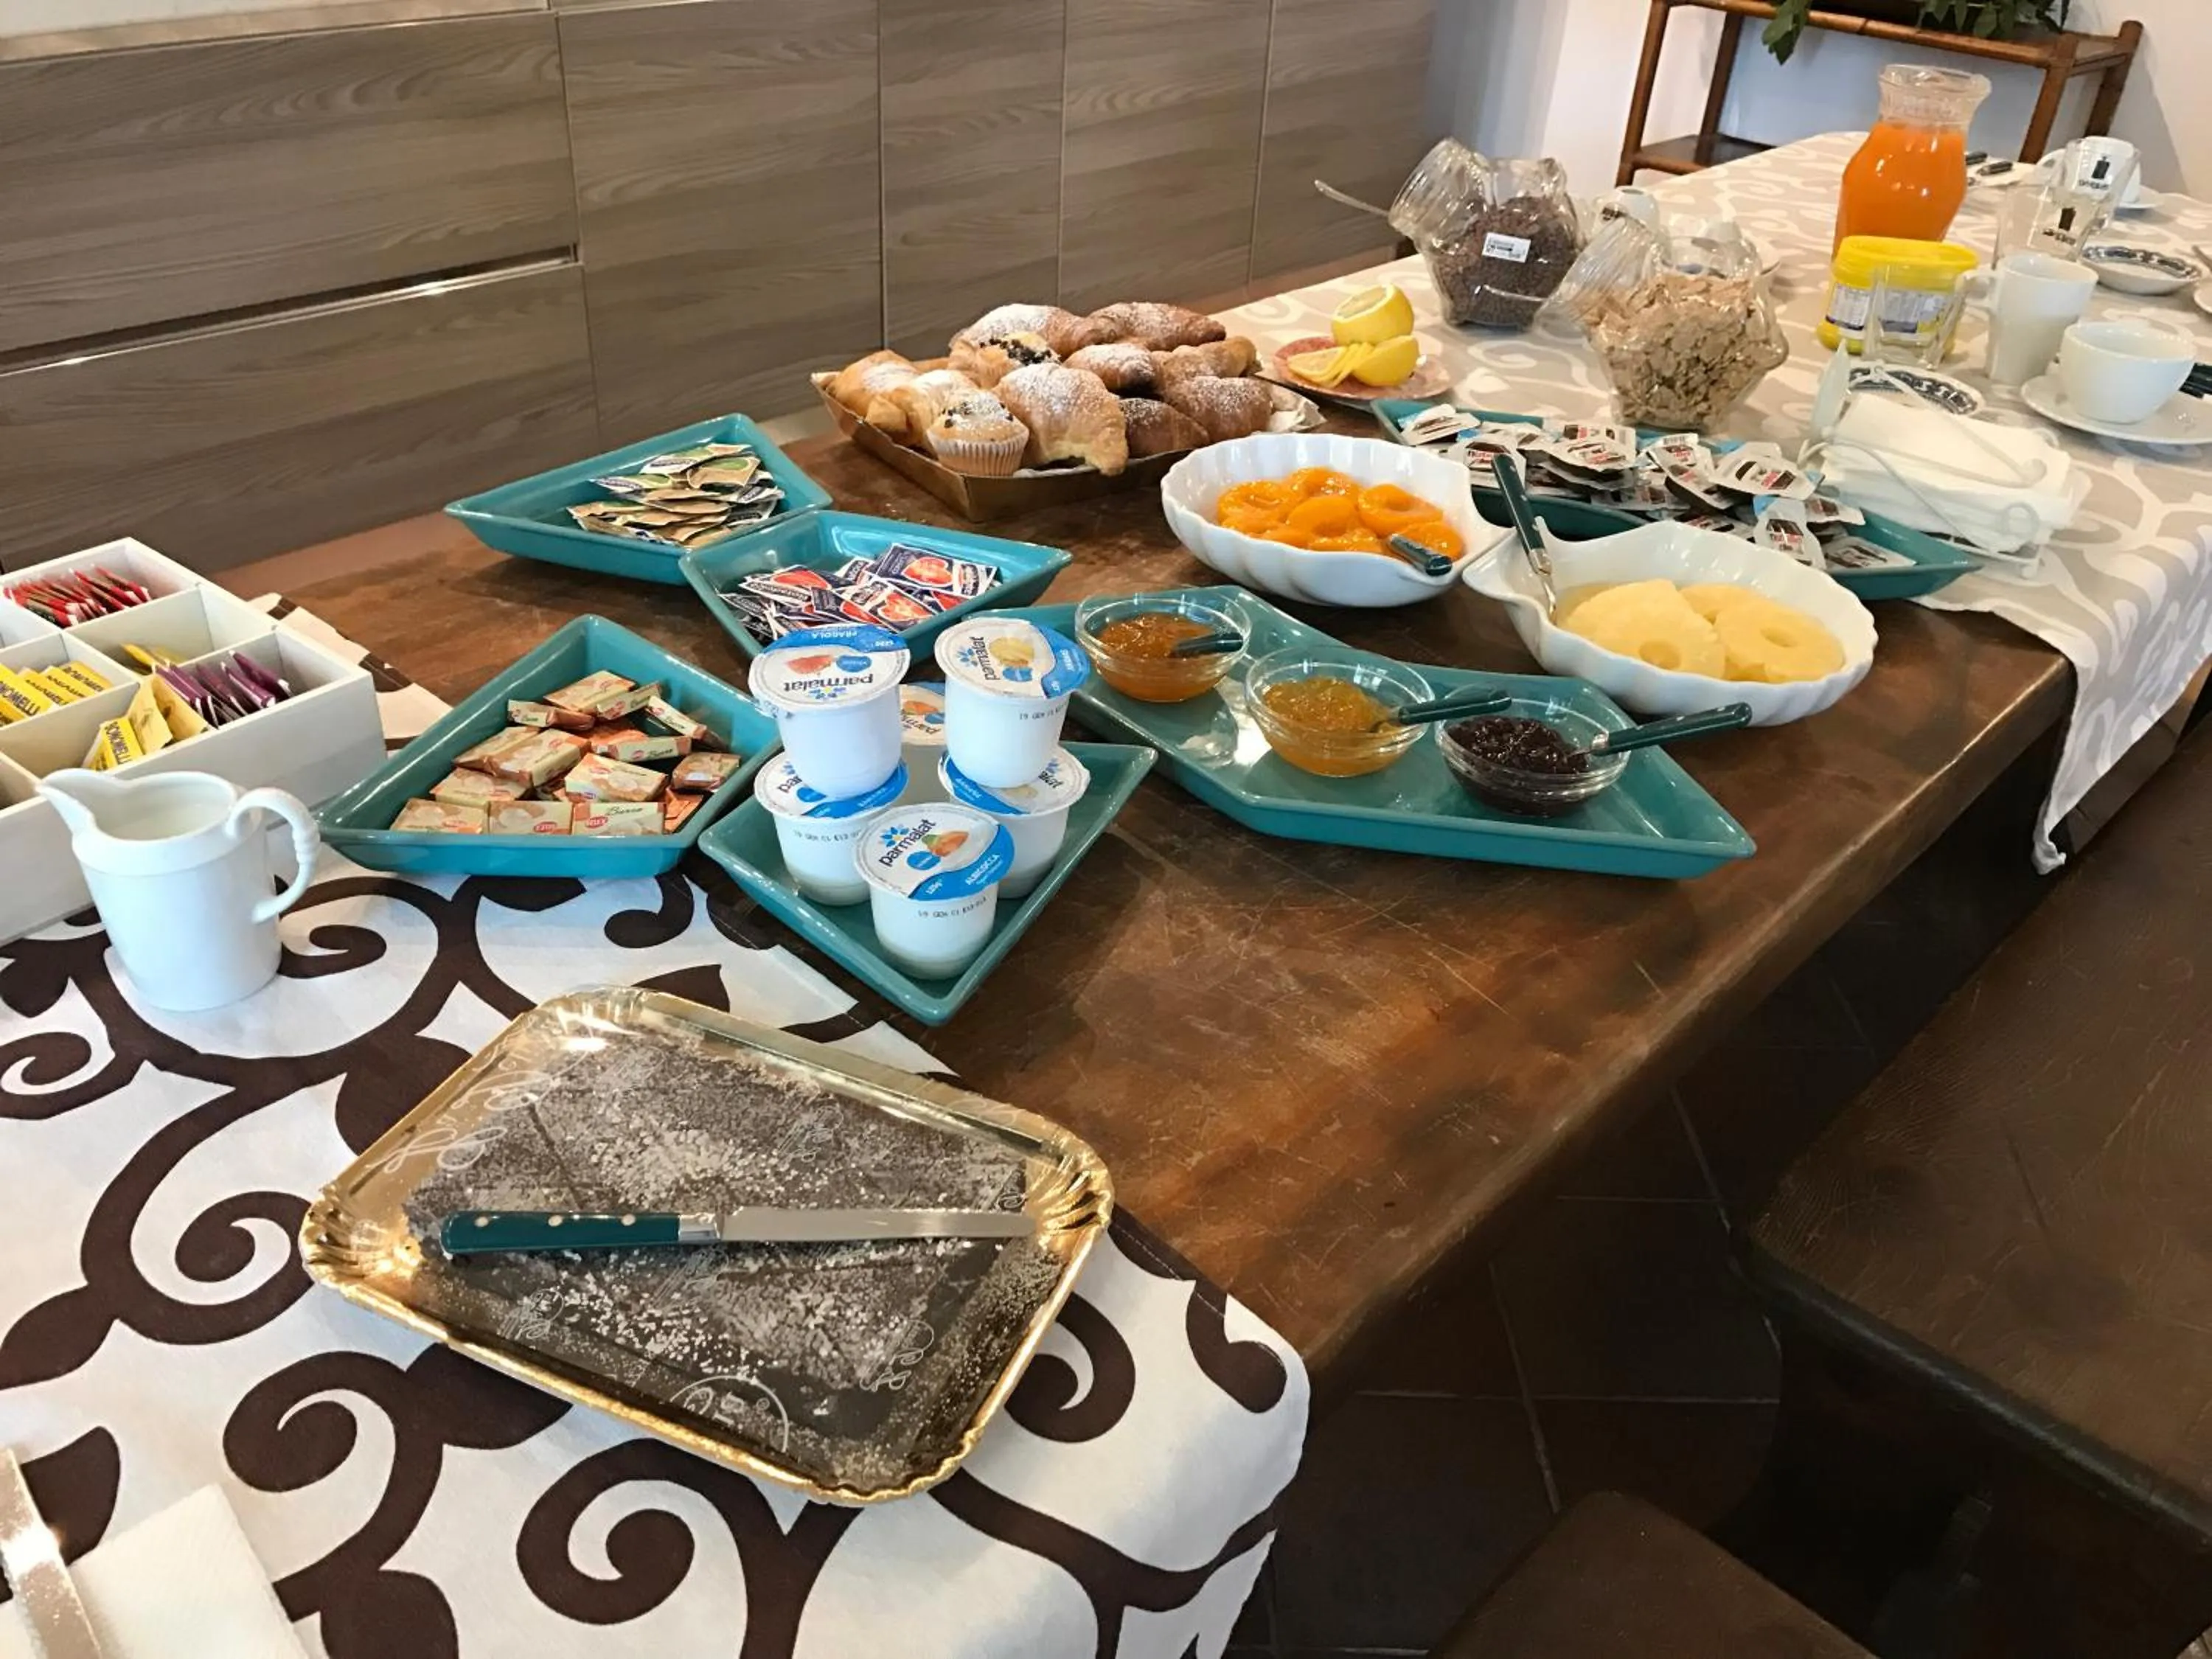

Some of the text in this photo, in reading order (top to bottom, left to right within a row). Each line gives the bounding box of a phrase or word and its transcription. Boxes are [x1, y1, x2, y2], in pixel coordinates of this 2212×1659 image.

[970, 636, 1001, 681] parmalat
[784, 674, 873, 692] parmalat
[879, 819, 936, 867] parmalat
